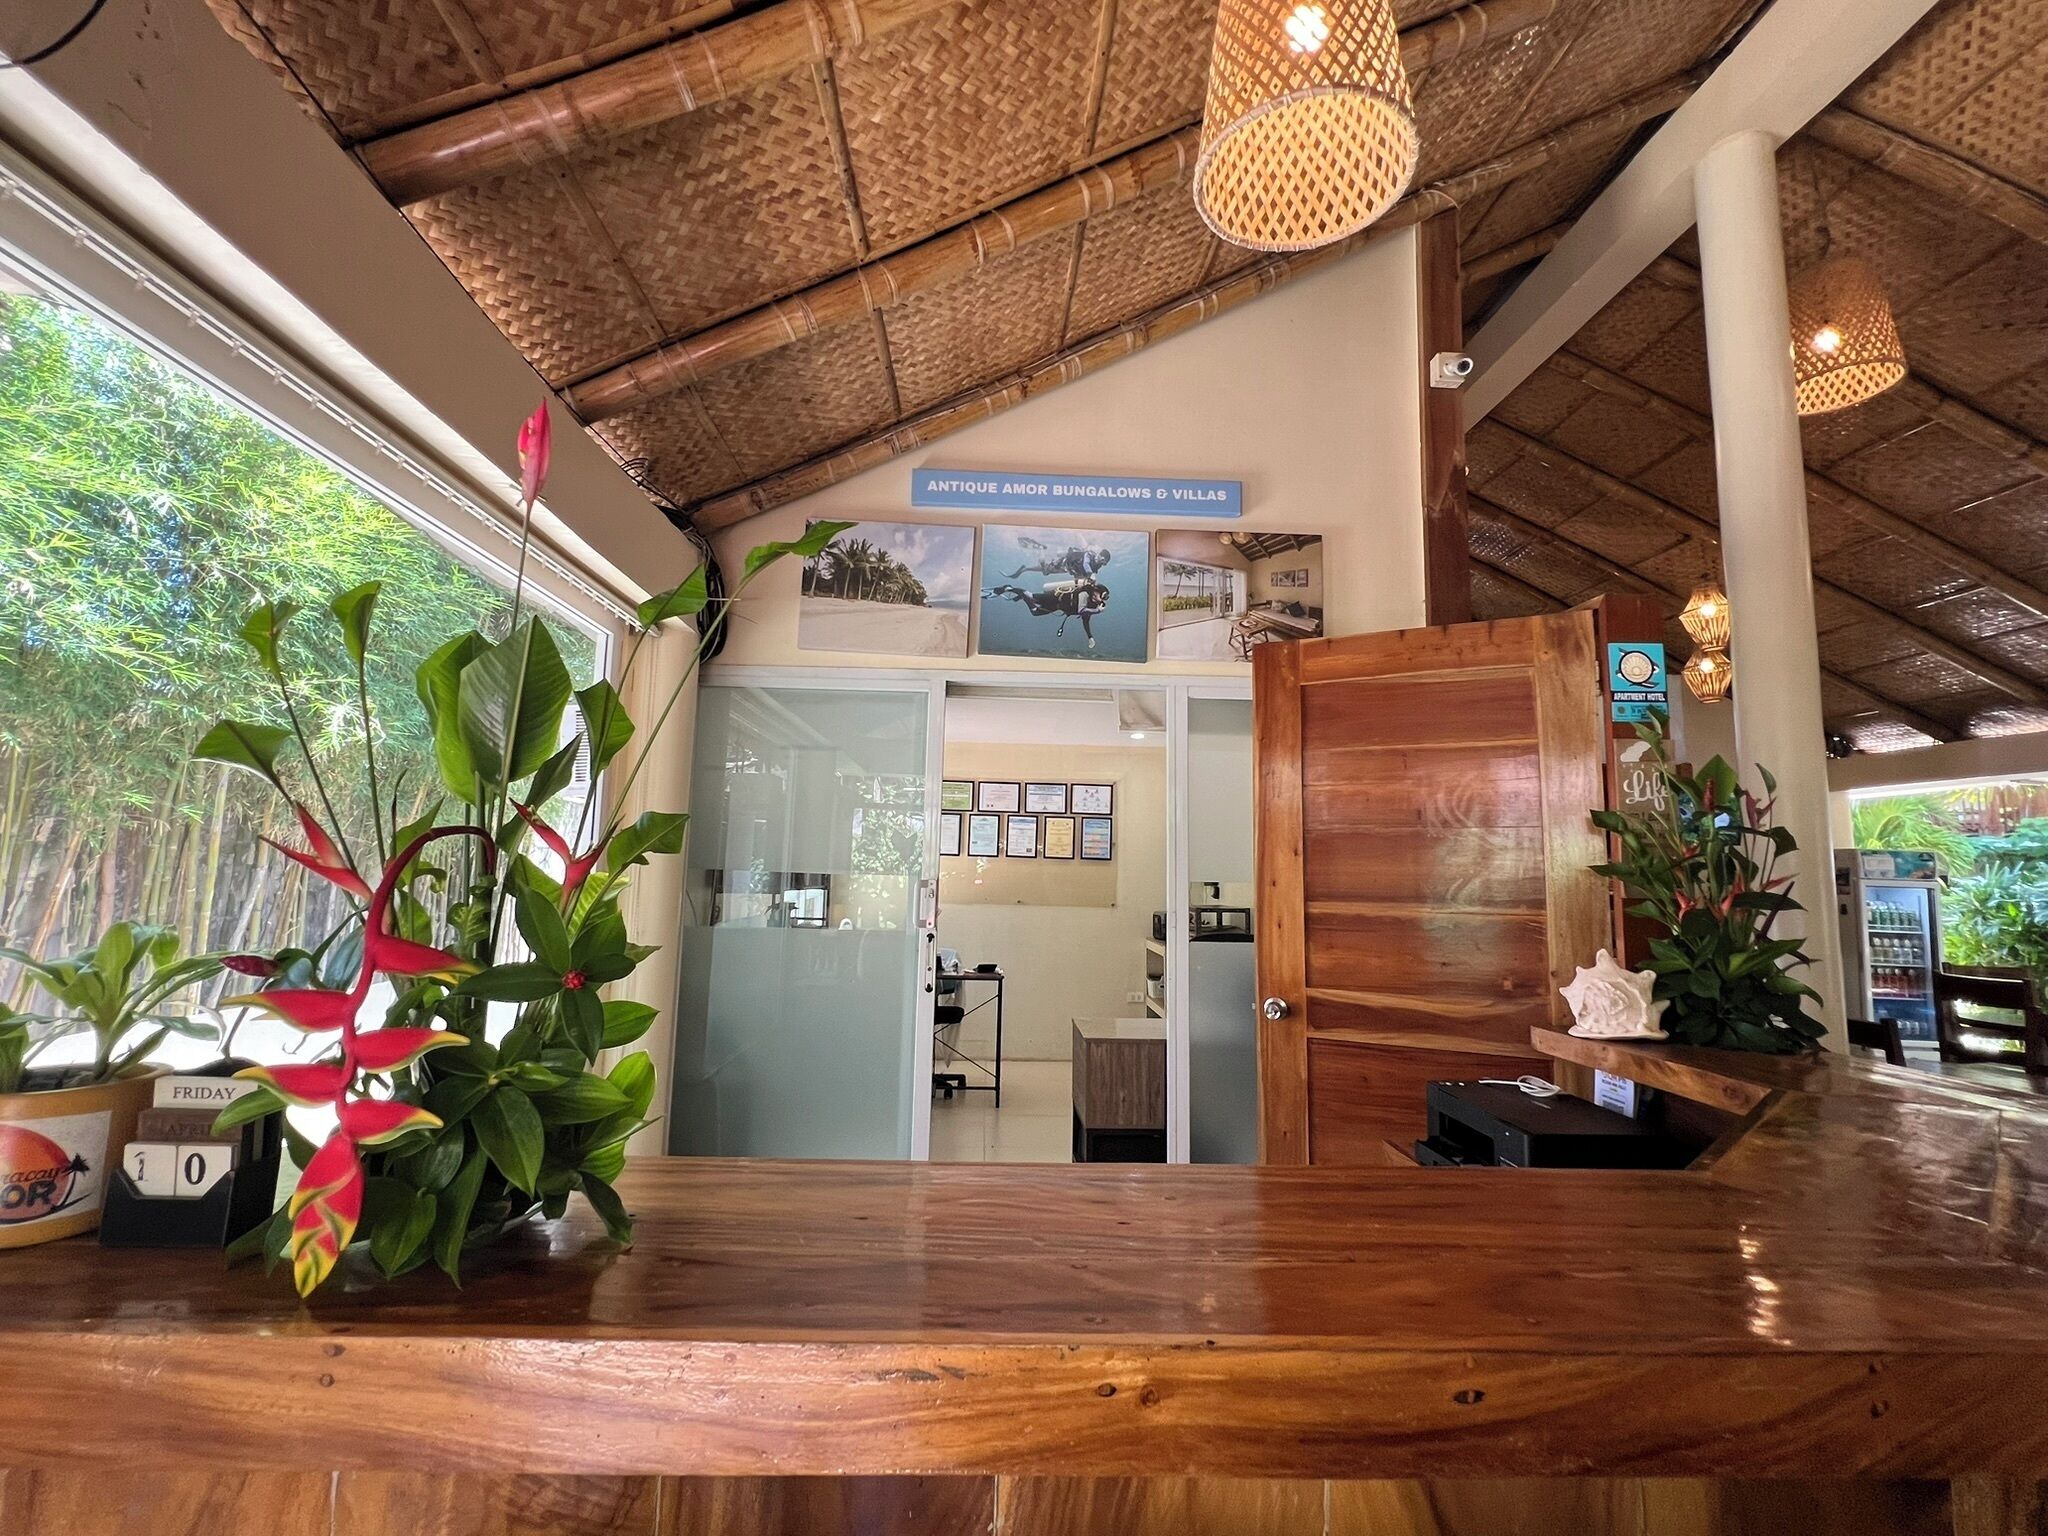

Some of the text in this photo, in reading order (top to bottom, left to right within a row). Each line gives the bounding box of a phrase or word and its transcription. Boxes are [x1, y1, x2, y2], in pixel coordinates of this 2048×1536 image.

[927, 480, 1227, 501] ANTIQUE AMOR BUNGALOWS & VILLAS
[1614, 693, 1666, 701] APARTMENT HOTEL
[173, 1087, 236, 1100] FRIDAY
